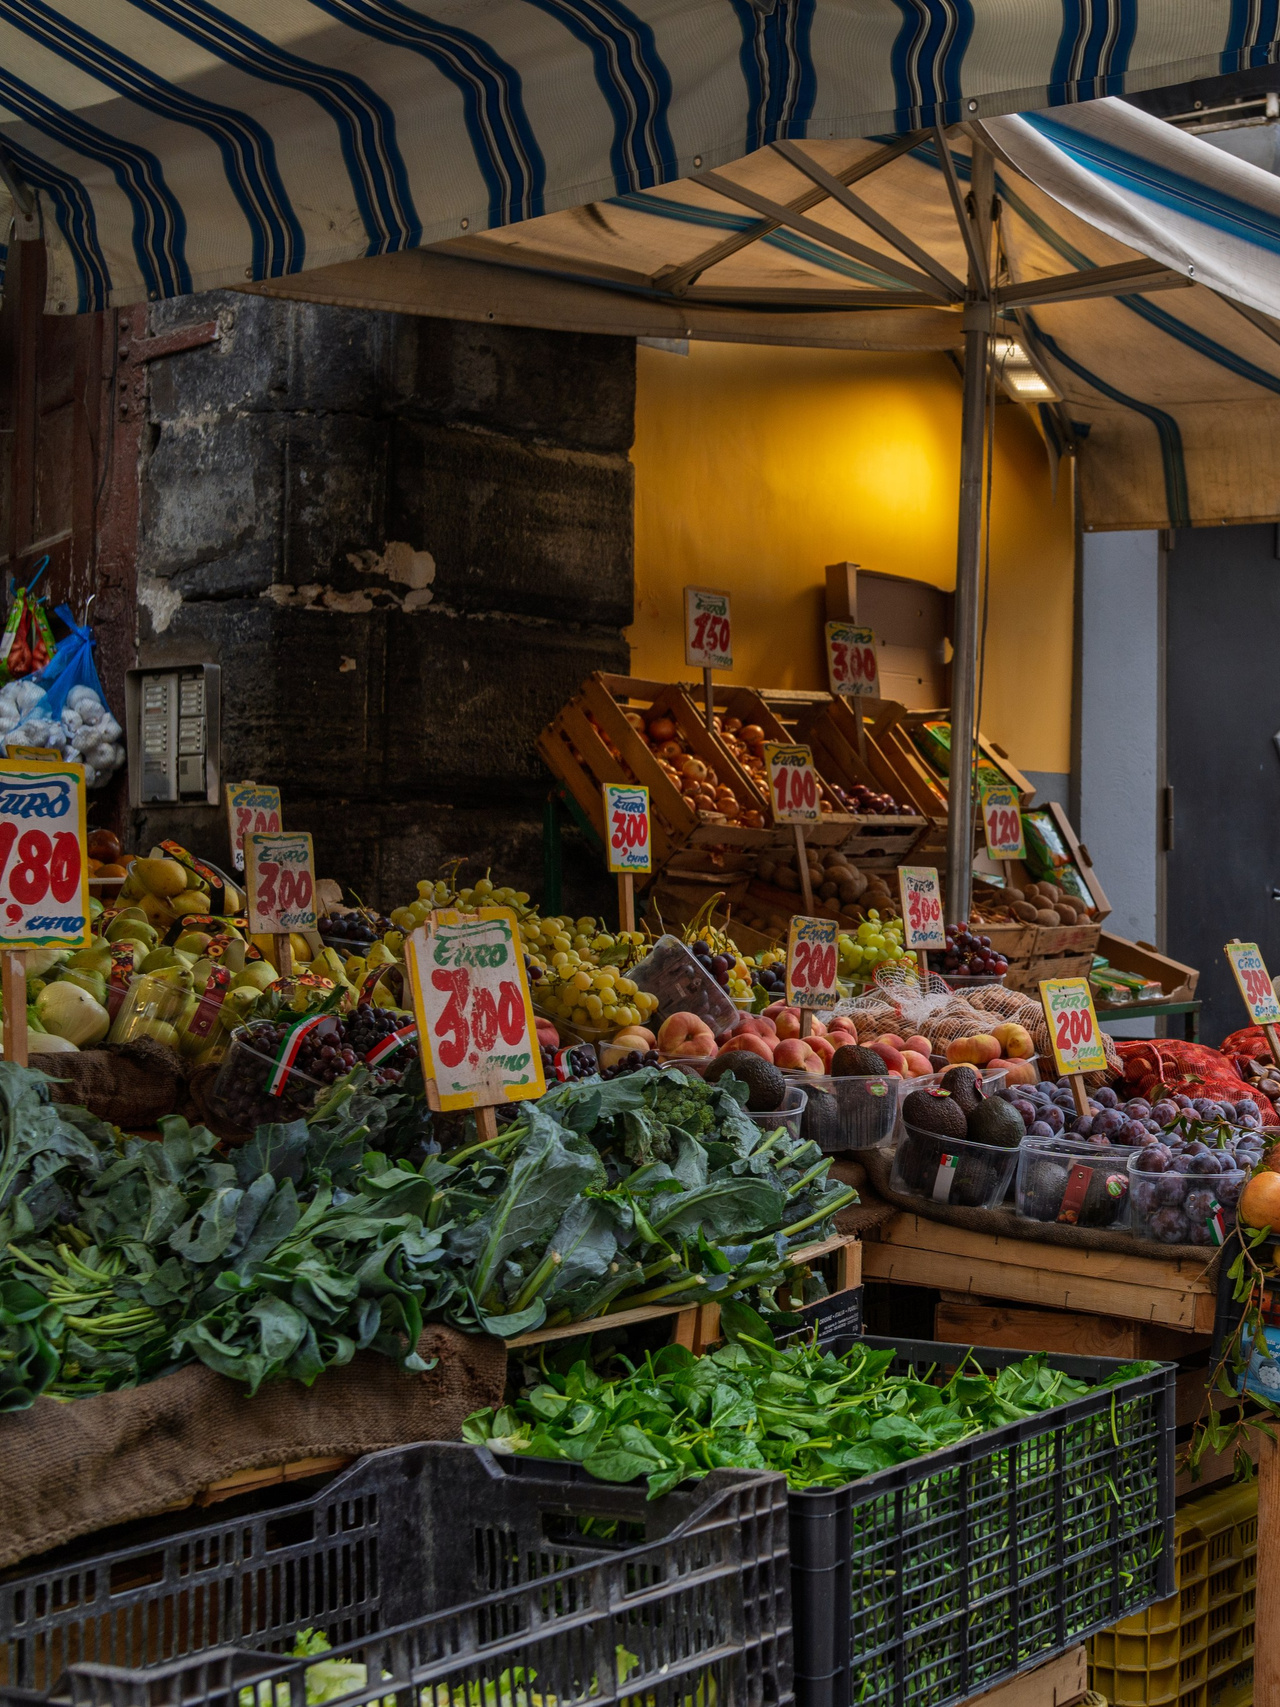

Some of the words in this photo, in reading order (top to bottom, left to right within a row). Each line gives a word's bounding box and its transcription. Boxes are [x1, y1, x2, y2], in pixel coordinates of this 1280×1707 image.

[772, 750, 811, 768] EURO
[0, 781, 71, 819] URO
[232, 789, 280, 811] EURO
[611, 795, 645, 814] EURO
[987, 793, 1012, 807] EURO
[257, 844, 308, 864] EURO
[797, 924, 836, 943] EURO
[430, 927, 513, 969] EURO
[1051, 991, 1090, 1012] EURO
